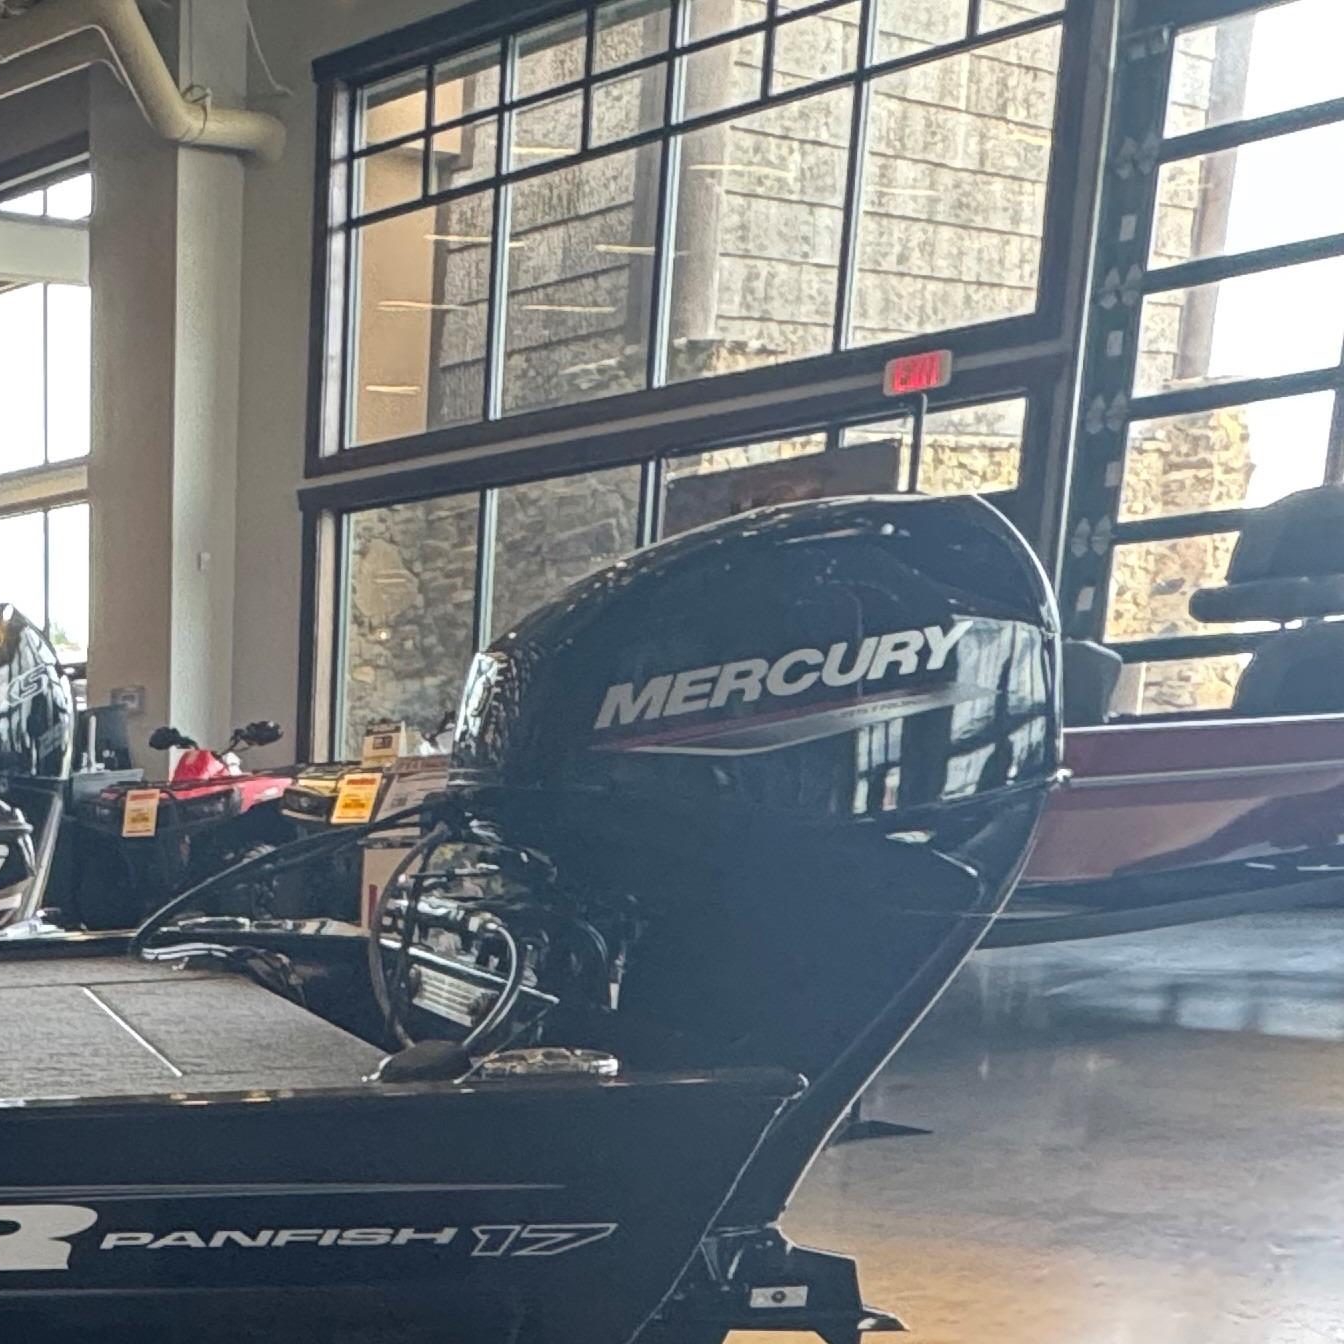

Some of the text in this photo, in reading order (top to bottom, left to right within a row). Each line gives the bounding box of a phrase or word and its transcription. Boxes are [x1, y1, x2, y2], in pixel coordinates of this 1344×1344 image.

[593, 620, 974, 730] MERCURY
[99, 1227, 458, 1250] PANFISH
[471, 1223, 619, 1257] 17
